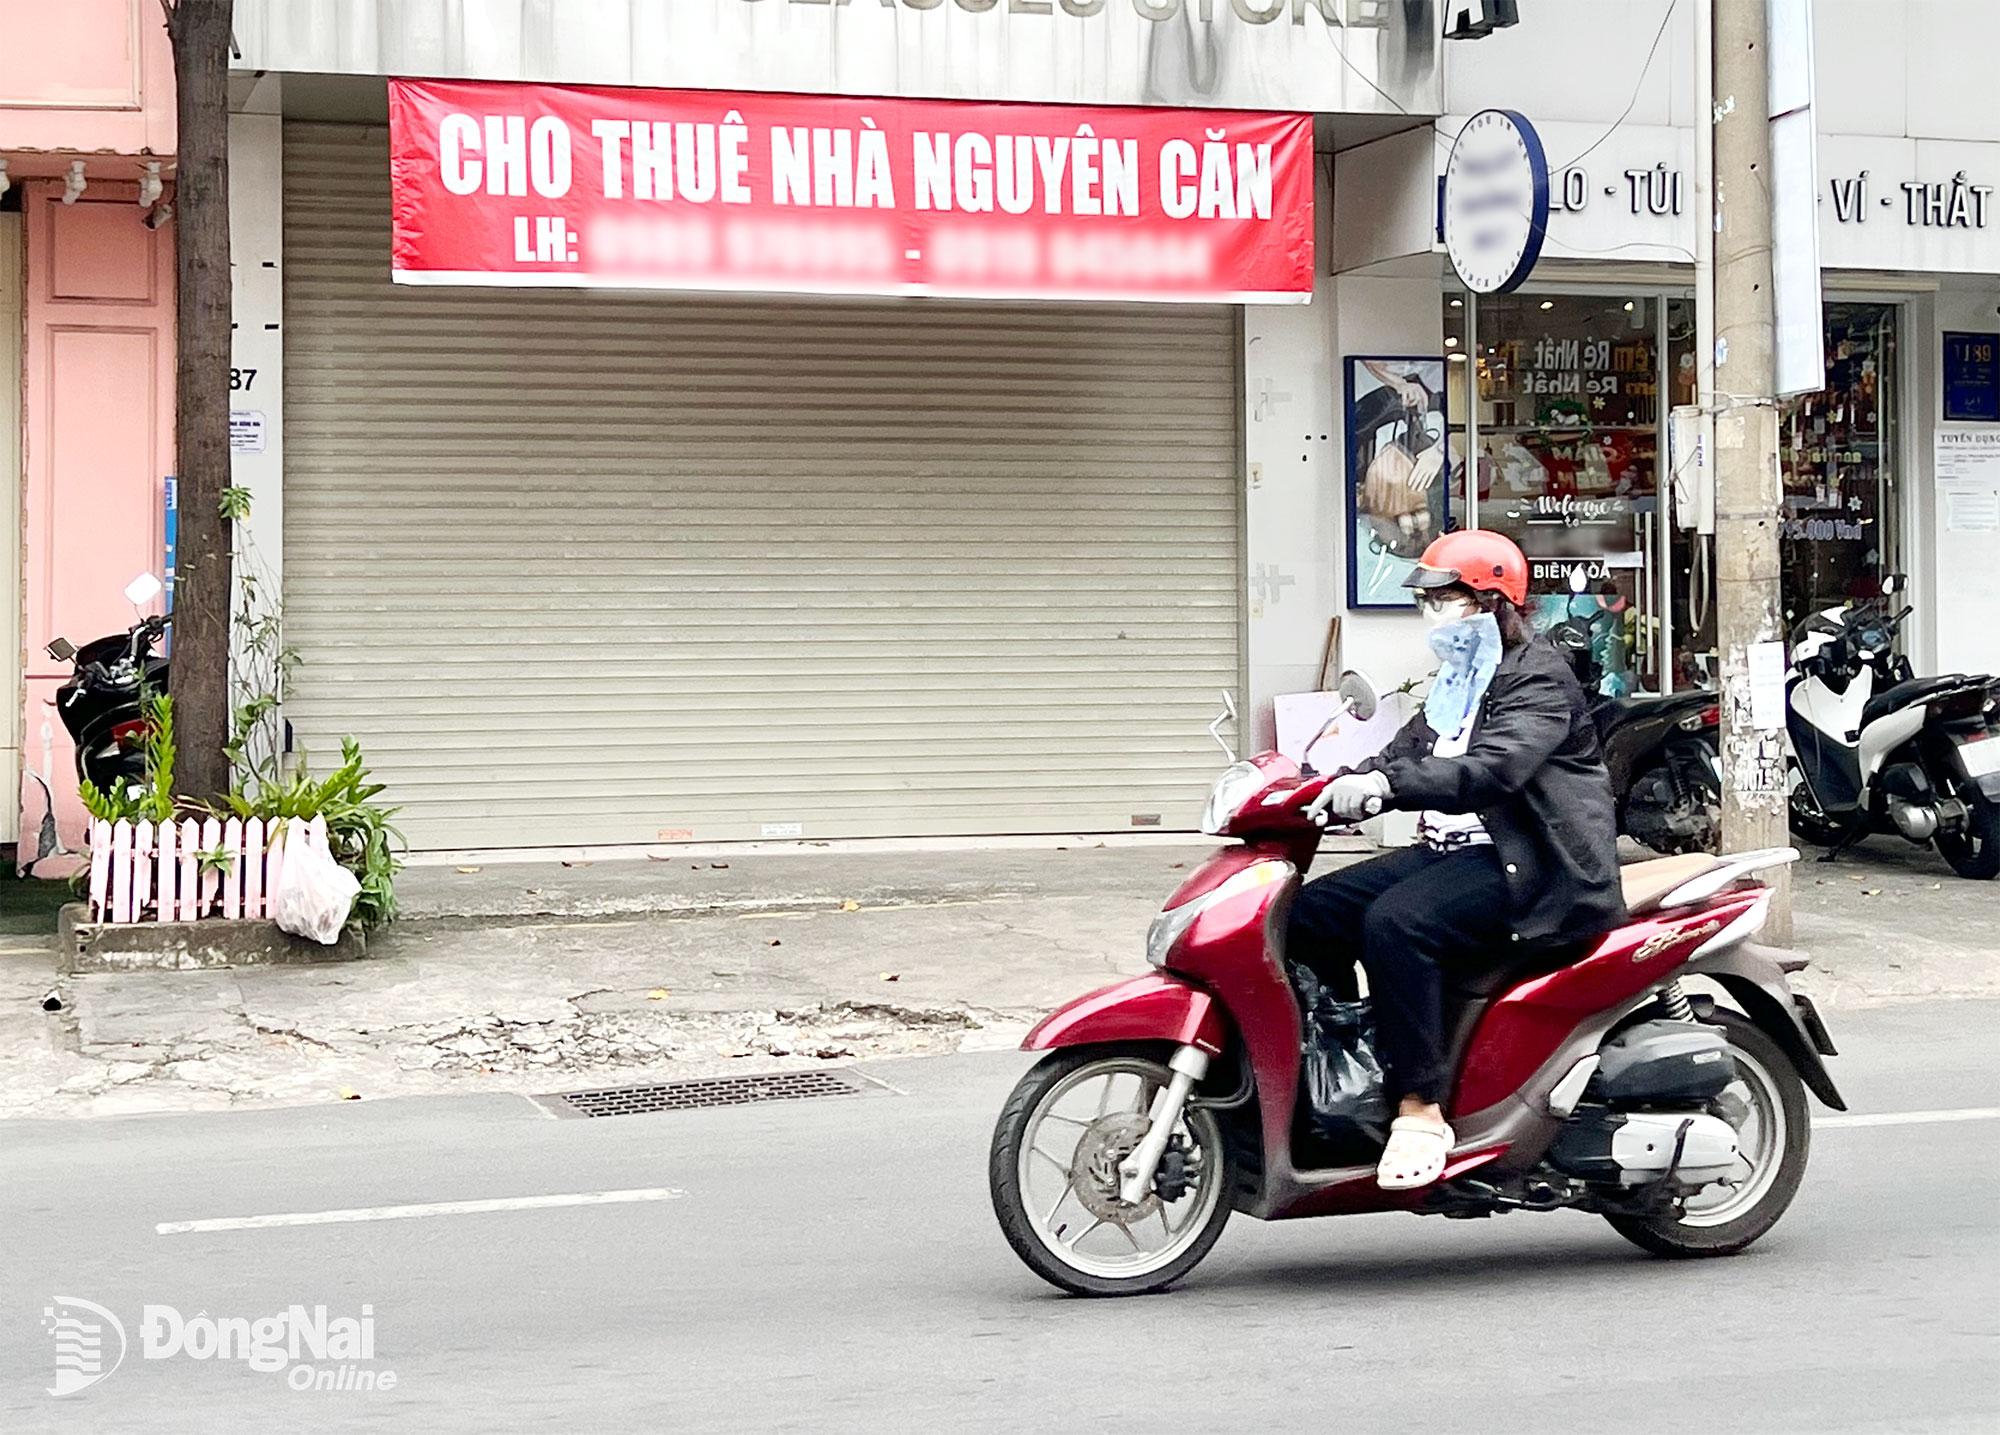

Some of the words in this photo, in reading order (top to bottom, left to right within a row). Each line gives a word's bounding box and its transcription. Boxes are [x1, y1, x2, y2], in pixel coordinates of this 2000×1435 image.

[438, 113, 573, 200] CHO
[592, 110, 752, 206] THUÊ
[771, 117, 895, 209] NHÀ
[913, 124, 1139, 217] NGUYÊN
[1159, 128, 1273, 220] CĂN
[1625, 162, 1684, 215] TÚI
[1831, 170, 1869, 223] VÍ
[1900, 170, 1993, 228] THẮT
[514, 216, 579, 263] LH:
[1534, 494, 1610, 519] Welcome
[1564, 515, 1580, 528] to
[1533, 561, 1572, 579] BIÊN
[1584, 561, 1611, 579] ÒA
